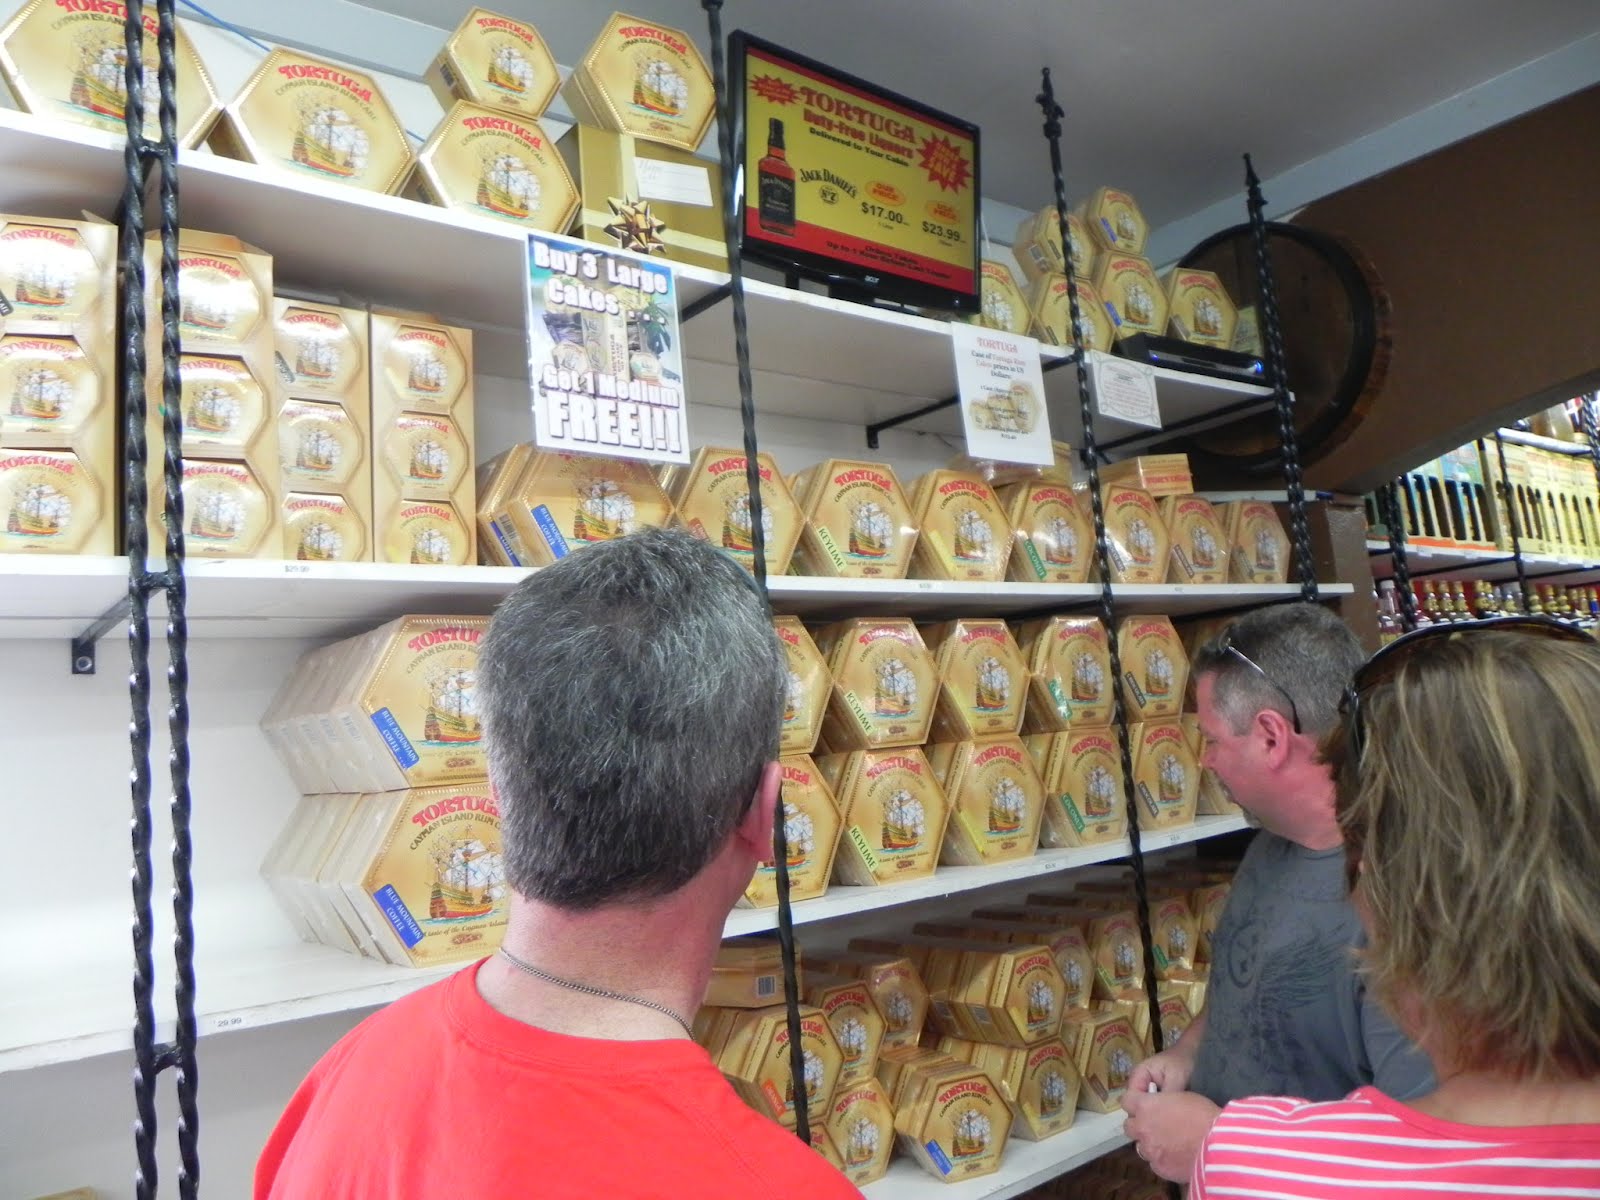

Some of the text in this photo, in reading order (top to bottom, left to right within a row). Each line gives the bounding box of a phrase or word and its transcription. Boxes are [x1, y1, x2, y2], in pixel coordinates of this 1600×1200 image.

[476, 18, 533, 42] TORTUGA
[619, 27, 687, 55] TORTUGA
[278, 64, 373, 103] TORTUGA
[800, 86, 917, 144] TORTUGA
[463, 116, 542, 150] TORTUGA
[809, 127, 850, 148] Delivered
[853, 142, 863, 151] to
[864, 146, 884, 158] Your
[800, 168, 858, 199] JACK DANIEL'S
[861, 201, 903, 224] $17.00
[922, 220, 961, 242] $23.99
[533, 241, 668, 294] Buy 3 Large
[549, 278, 619, 315] Cakes
[287, 313, 343, 330] TORTUGA
[398, 330, 448, 349] TORTUGA
[976, 336, 1018, 353] TORTUGA
[971, 350, 985, 358] Case
[993, 363, 1010, 372] prices
[1016, 366, 1025, 374] US
[541, 363, 680, 409] Get 1 Medium
[548, 392, 682, 454] FREE!!!
[834, 469, 894, 492] TORTUGA
[939, 479, 987, 501] TORTUGA
[288, 498, 344, 515] TORTUGA
[1032, 487, 1074, 507] TORTUGA
[401, 504, 450, 521] TORTUGA
[540, 506, 554, 523] BLUE
[541, 523, 555, 547] COFFEE
[1025, 540, 1045, 578] COCONUT
[961, 626, 1008, 644] TORTUGA
[1133, 623, 1171, 639] TORTUGA
[406, 642, 467, 674] CAYMAN ISLAND
[382, 710, 417, 762] BLUE MOUNTAIN
[383, 729, 401, 752] COFFEE
[1071, 735, 1115, 755] TORTUGA
[1145, 727, 1183, 745] TORTUGA
[866, 756, 922, 779] TORTUGA
[974, 745, 1023, 767] TORTUGA
[1063, 794, 1083, 831] COCONUT
[409, 812, 495, 851] CAYMAN ISLAND RUM
[385, 887, 421, 940] BLUE MOUNTAIN
[386, 907, 405, 932] COFFEE
[835, 1090, 878, 1113] TORTUGA
[938, 1081, 988, 1104] TORTUGA
